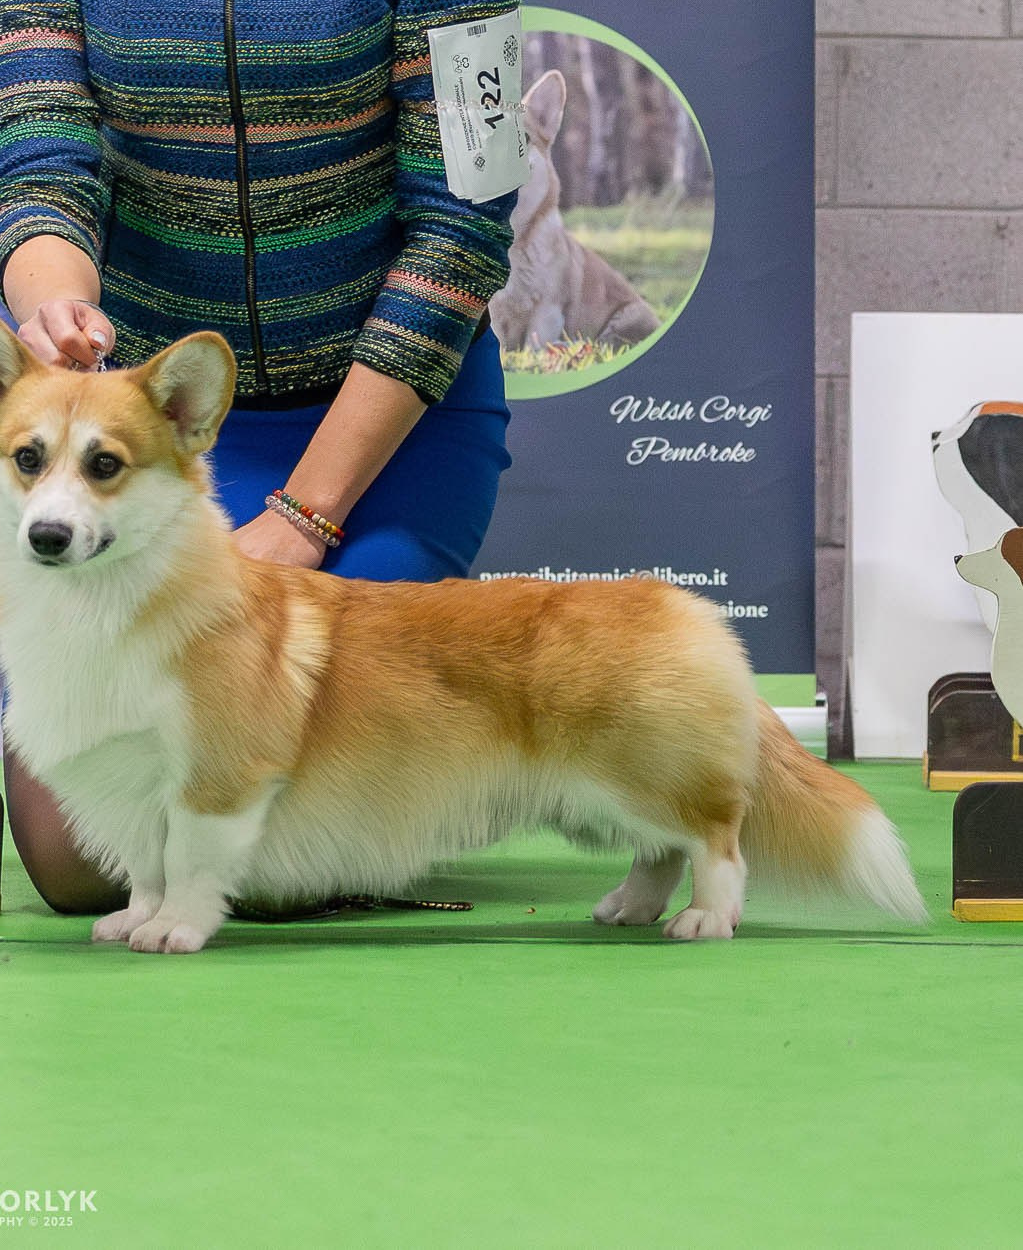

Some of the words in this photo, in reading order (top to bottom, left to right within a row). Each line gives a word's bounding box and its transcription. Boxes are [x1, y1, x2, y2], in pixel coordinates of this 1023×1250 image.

[476, 66, 505, 130] 122
[609, 395, 697, 424] Welsh
[699, 395, 773, 428] Corgi
[626, 436, 757, 466] Pembroke
